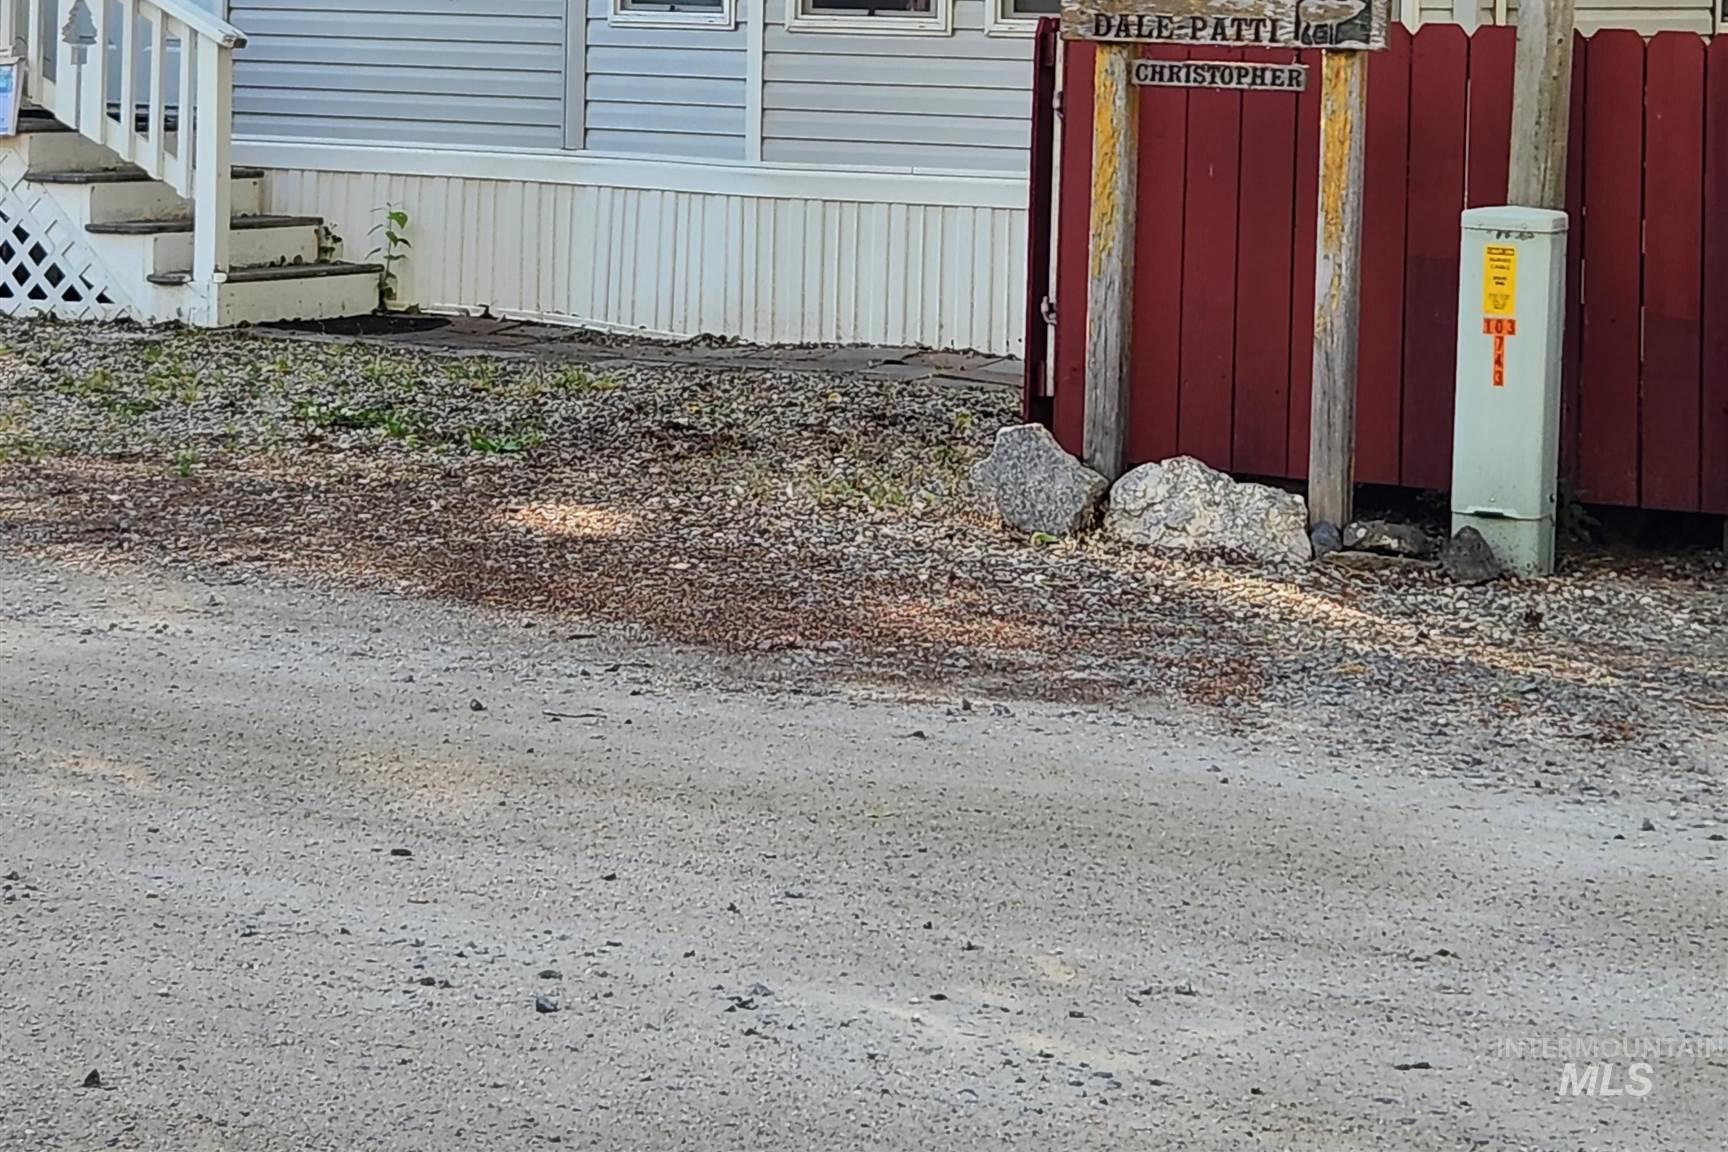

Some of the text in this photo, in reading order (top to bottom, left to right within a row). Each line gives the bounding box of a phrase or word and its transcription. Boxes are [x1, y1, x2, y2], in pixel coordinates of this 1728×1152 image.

[1093, 13, 1279, 44] DALE PATTI
[1135, 63, 1304, 88] CHRISTOPHER
[1483, 319, 1516, 335] 103
